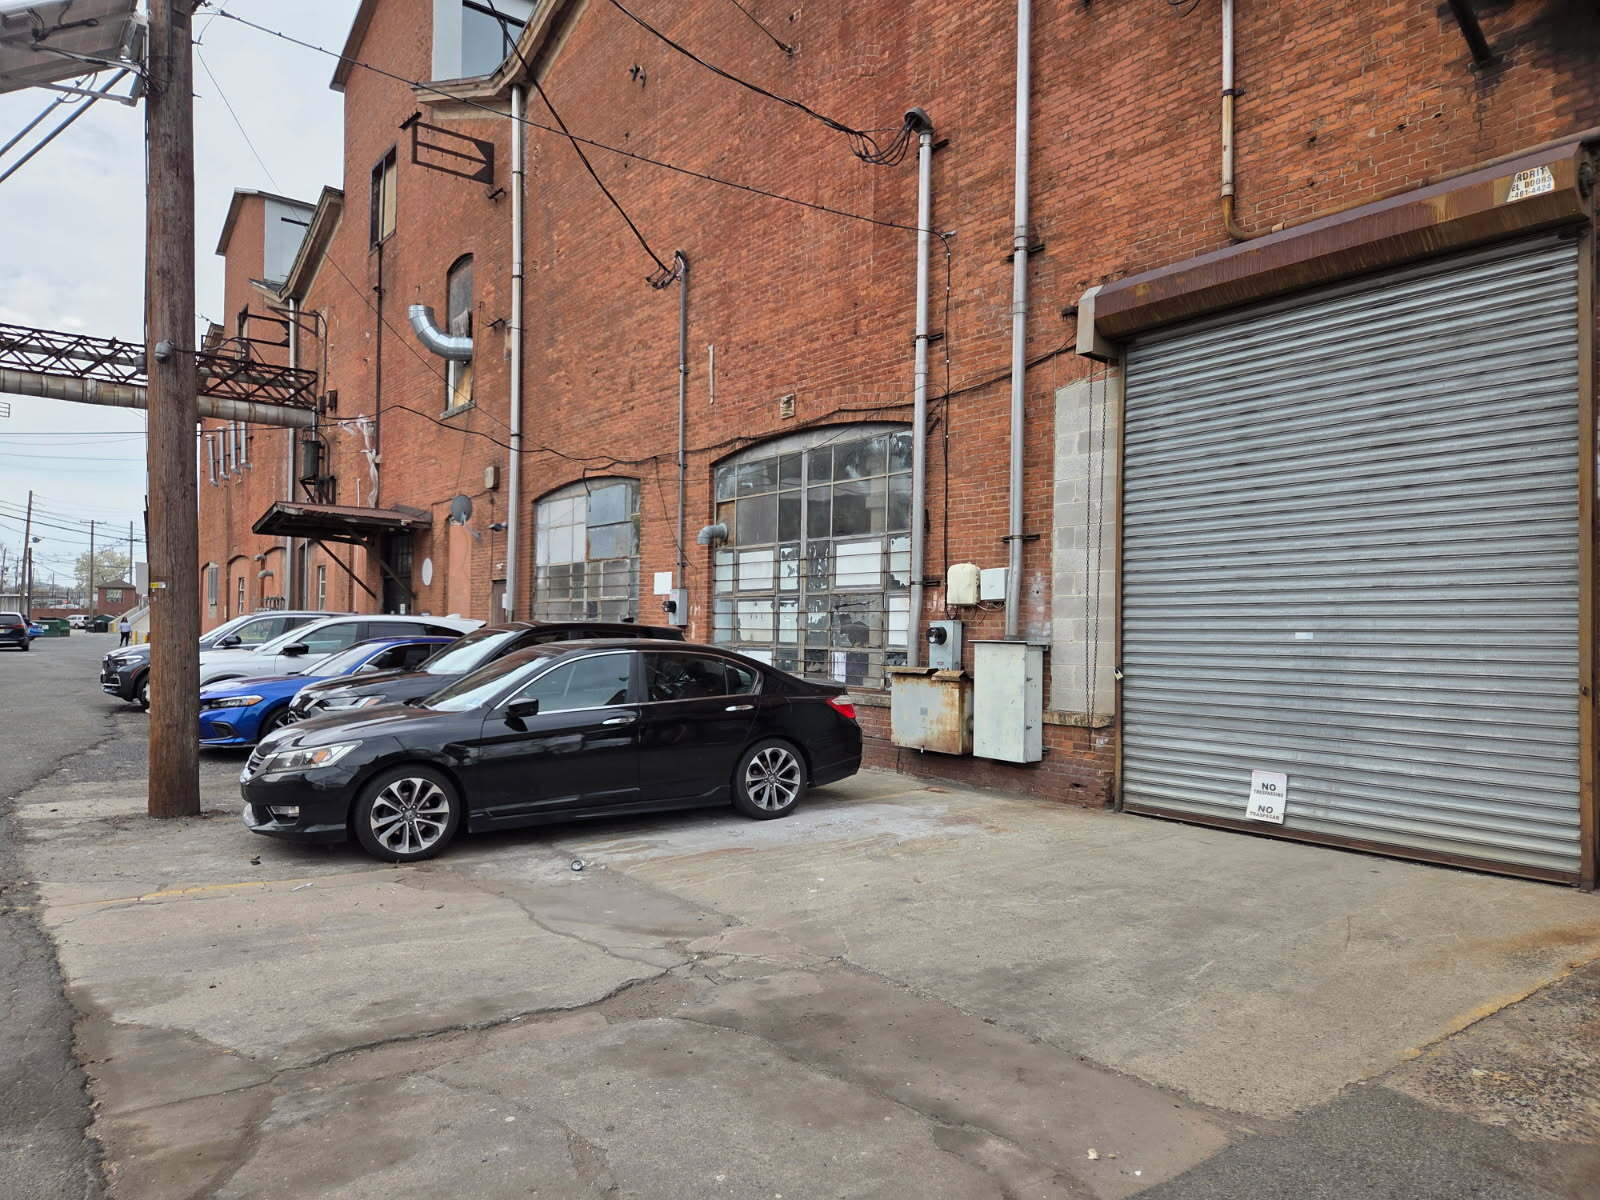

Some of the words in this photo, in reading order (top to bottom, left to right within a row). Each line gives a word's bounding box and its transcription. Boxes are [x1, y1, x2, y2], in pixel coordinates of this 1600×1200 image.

[1524, 175, 1552, 188] DOORS
[1261, 782, 1276, 791] NO
[1258, 805, 1273, 814] NO
